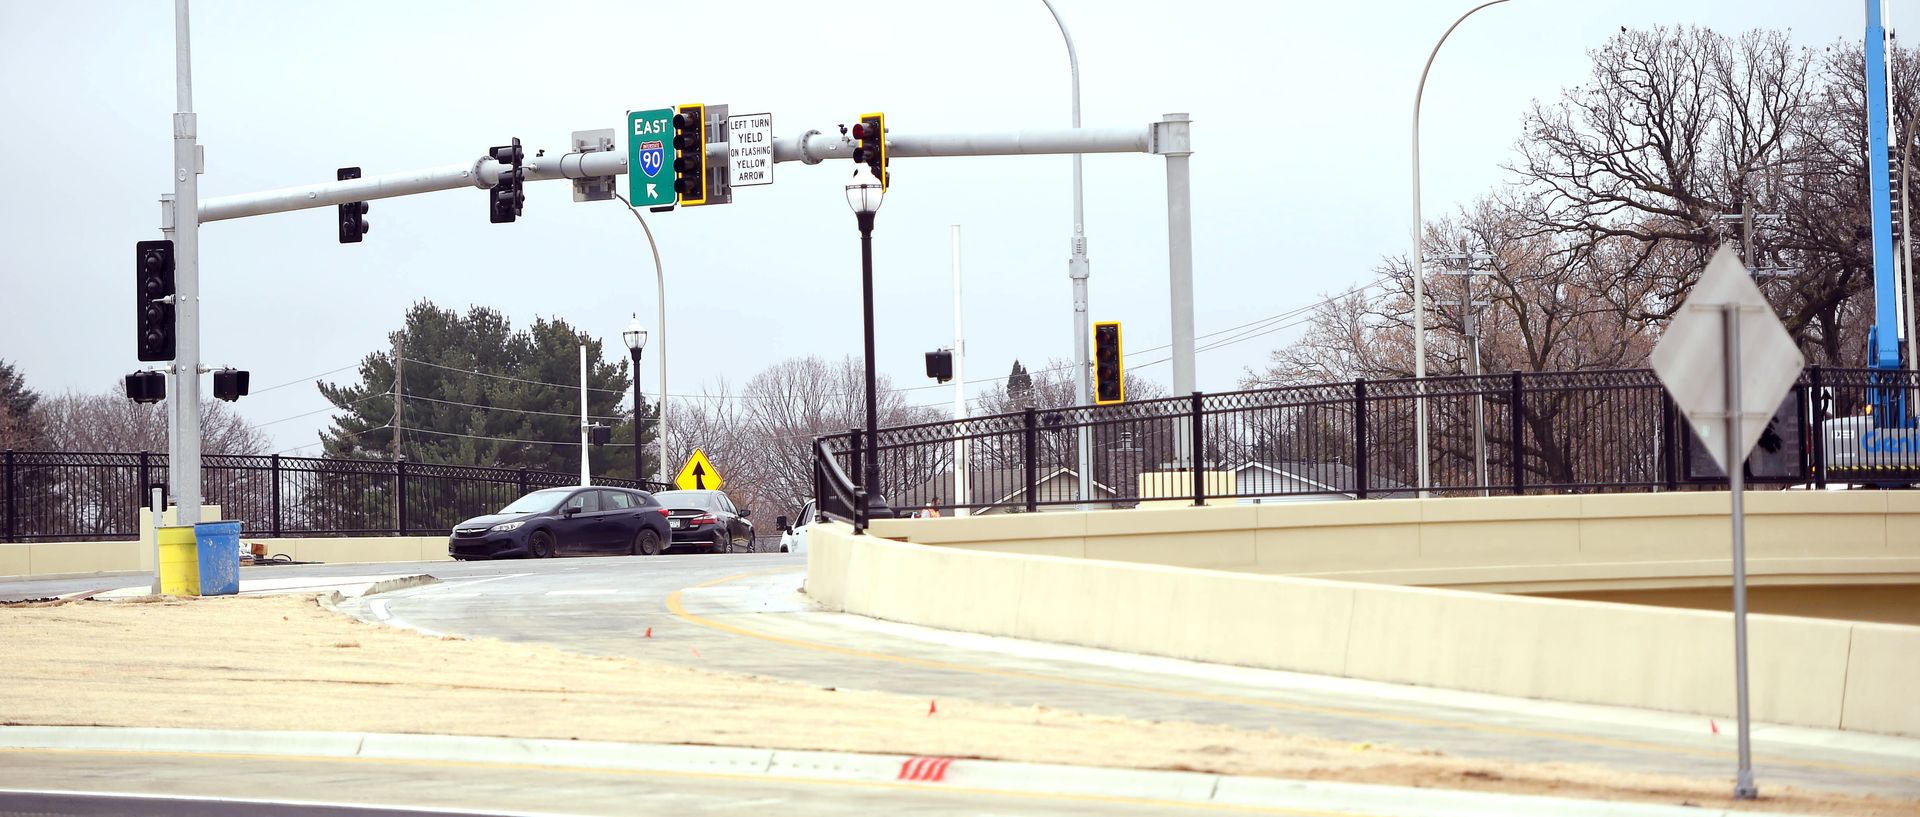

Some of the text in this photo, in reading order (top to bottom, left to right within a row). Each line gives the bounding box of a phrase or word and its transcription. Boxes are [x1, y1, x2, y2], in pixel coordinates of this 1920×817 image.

[634, 119, 668, 135] EAST
[731, 118, 769, 130] LEFT TURN
[738, 132, 763, 143] YIELD
[731, 145, 770, 157] ON FLASHING
[643, 151, 661, 169] 90
[737, 159, 765, 169] YELLOW
[739, 171, 764, 181] ARROW
